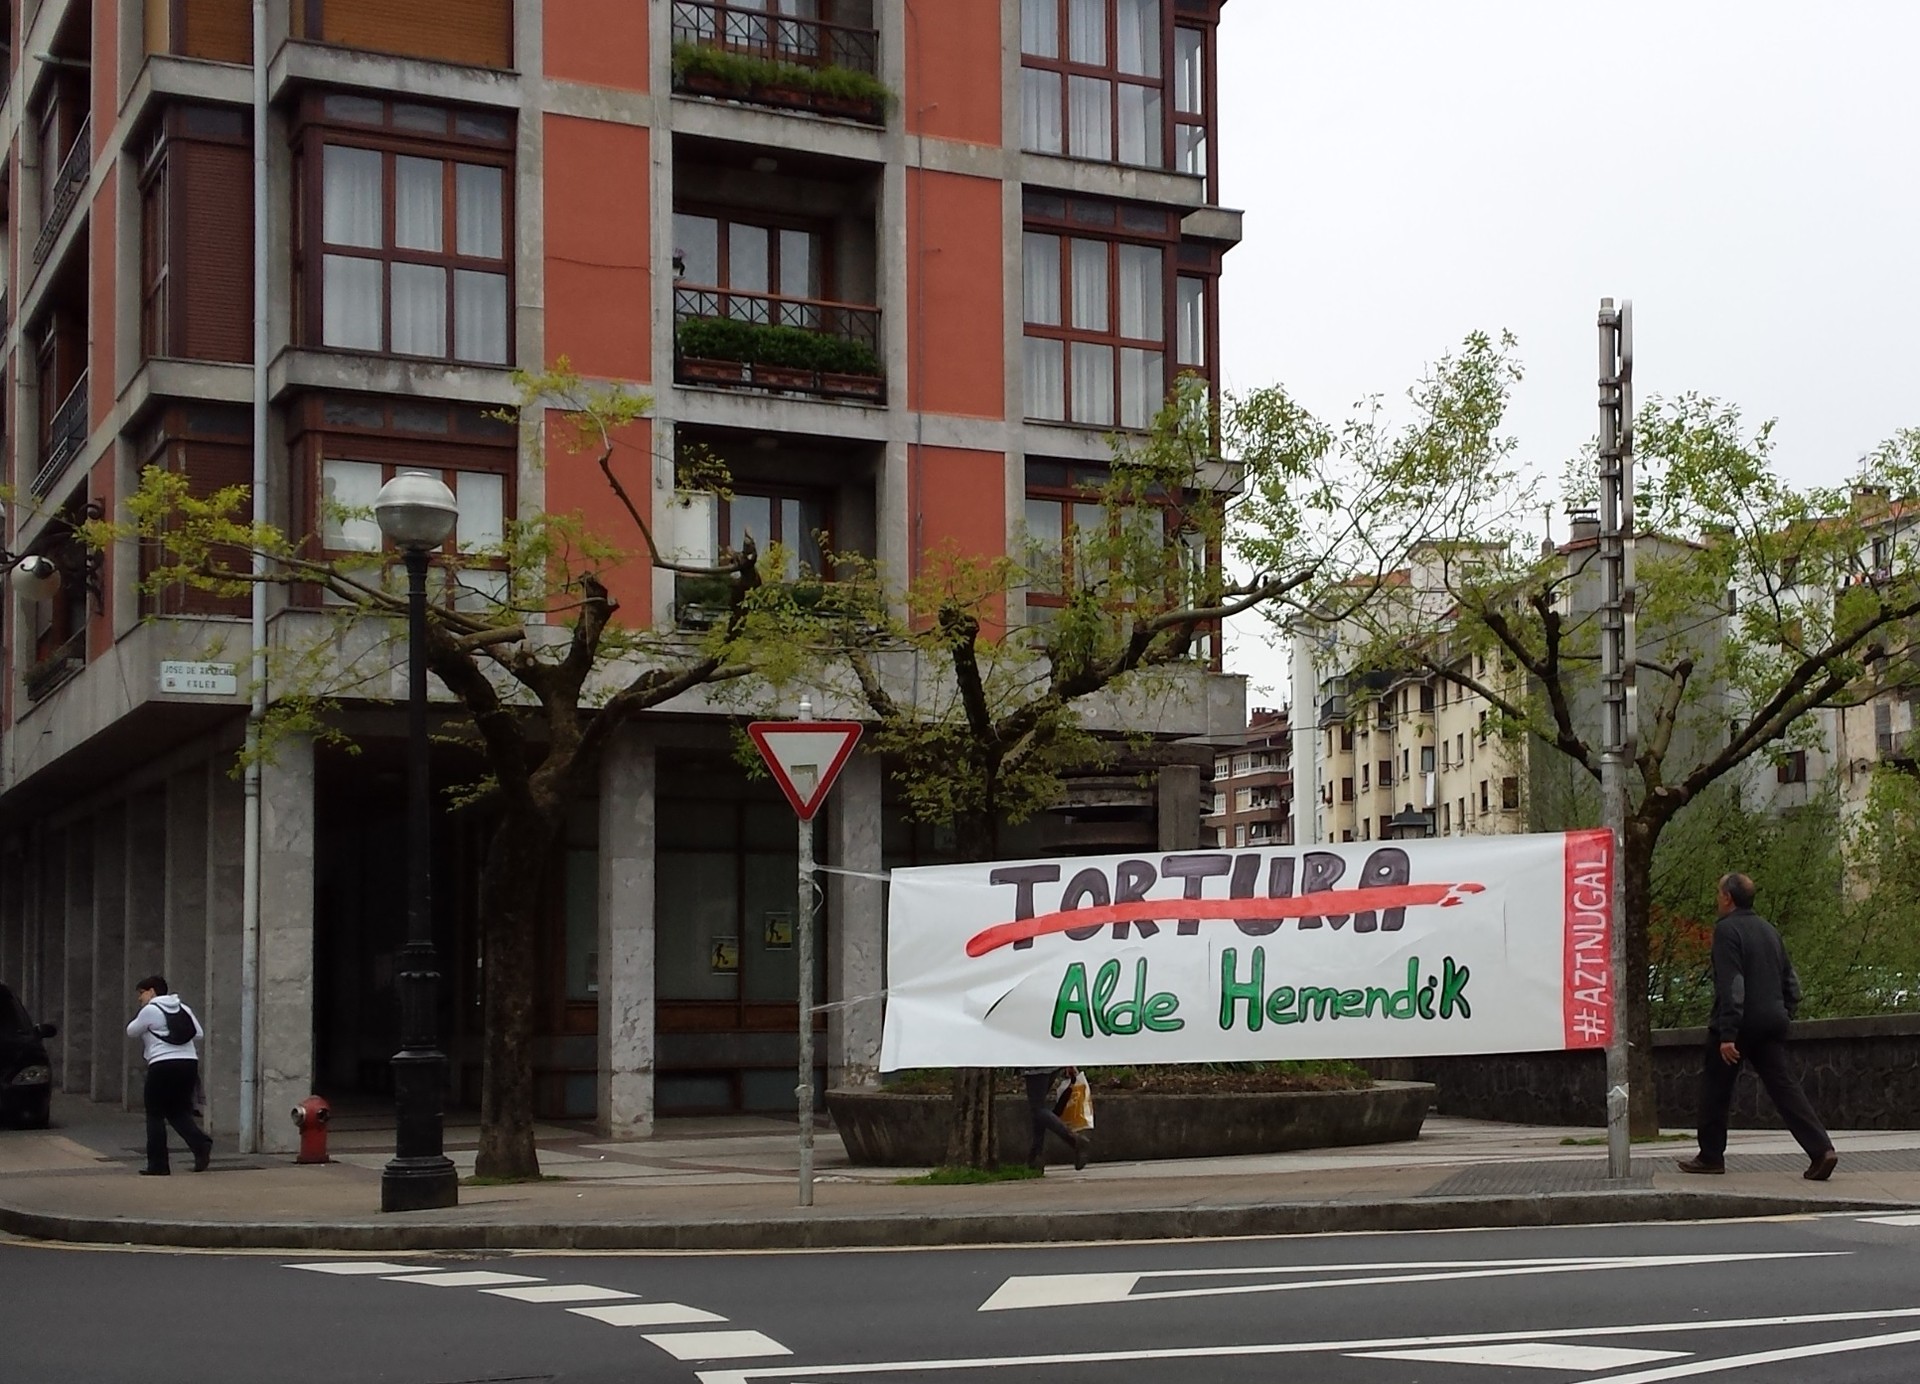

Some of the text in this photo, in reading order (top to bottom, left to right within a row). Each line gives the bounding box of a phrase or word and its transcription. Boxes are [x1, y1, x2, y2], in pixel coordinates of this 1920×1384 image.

[186, 666, 196, 675] DE
[990, 847, 1411, 951] TORTURA
[1573, 849, 1607, 1042] #AZTNUGAL
[1051, 946, 1471, 1038] Alde Hemendik
